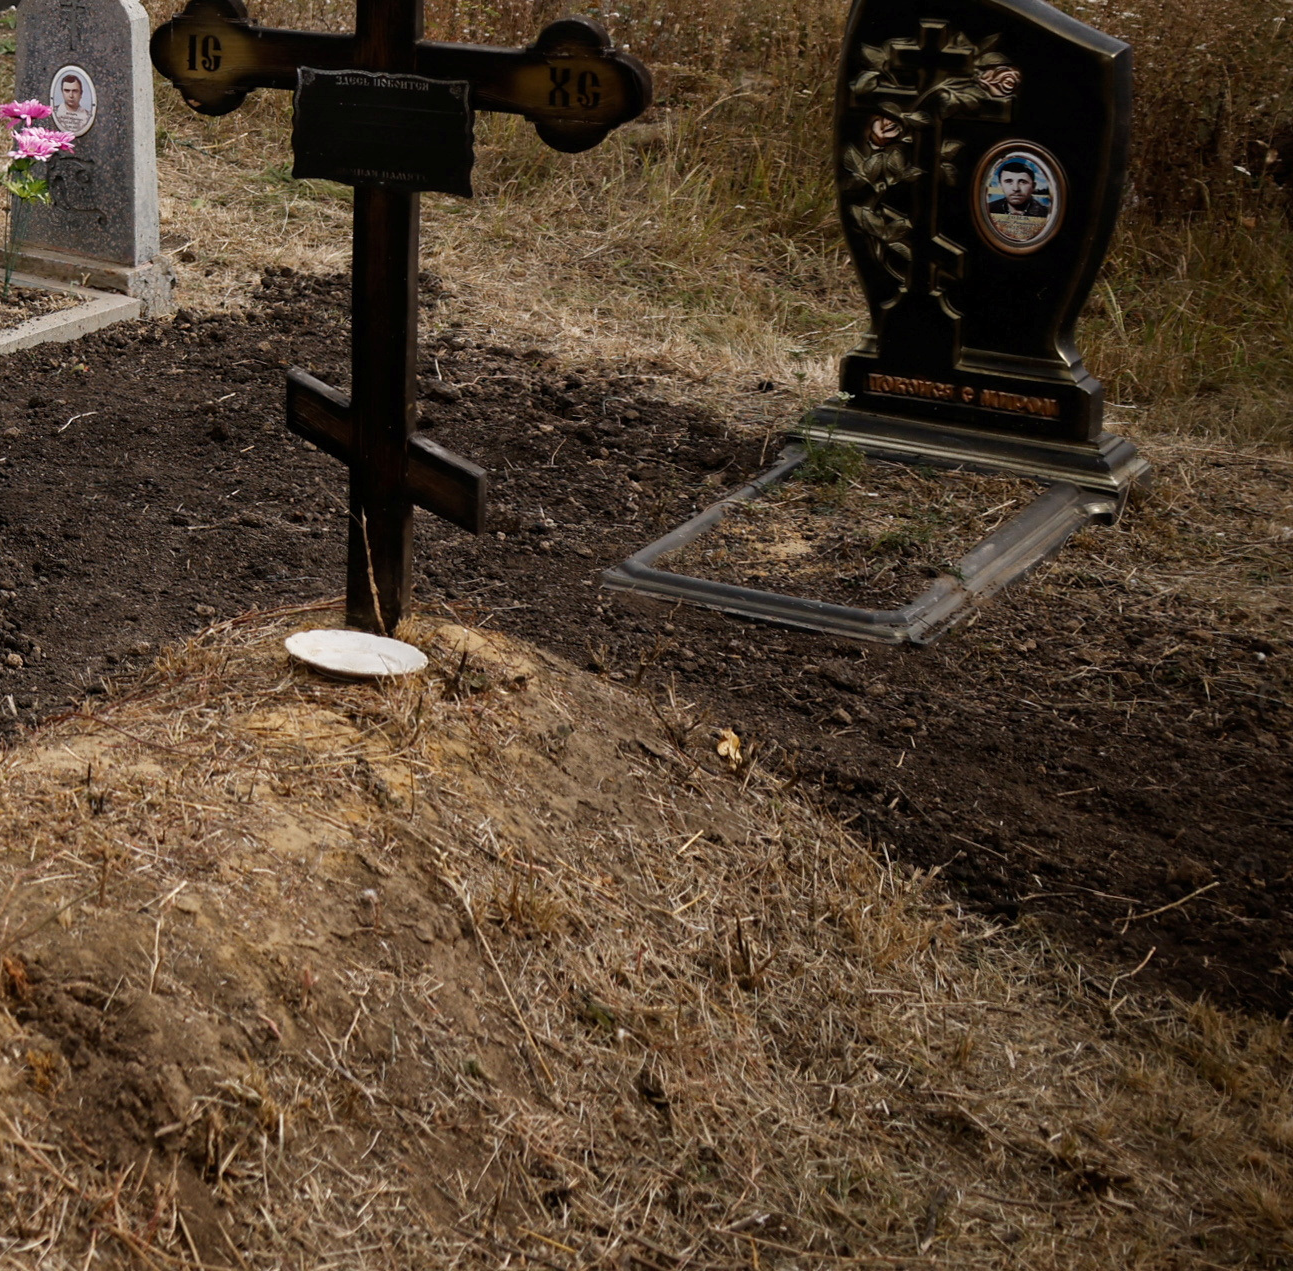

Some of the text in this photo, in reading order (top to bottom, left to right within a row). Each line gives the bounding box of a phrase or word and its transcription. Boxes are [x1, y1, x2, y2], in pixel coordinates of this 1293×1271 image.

[335, 75, 430, 92] ЗДЕСЬ ПОКОИТСЯ
[980, 388, 1061, 417] МИРОМ
